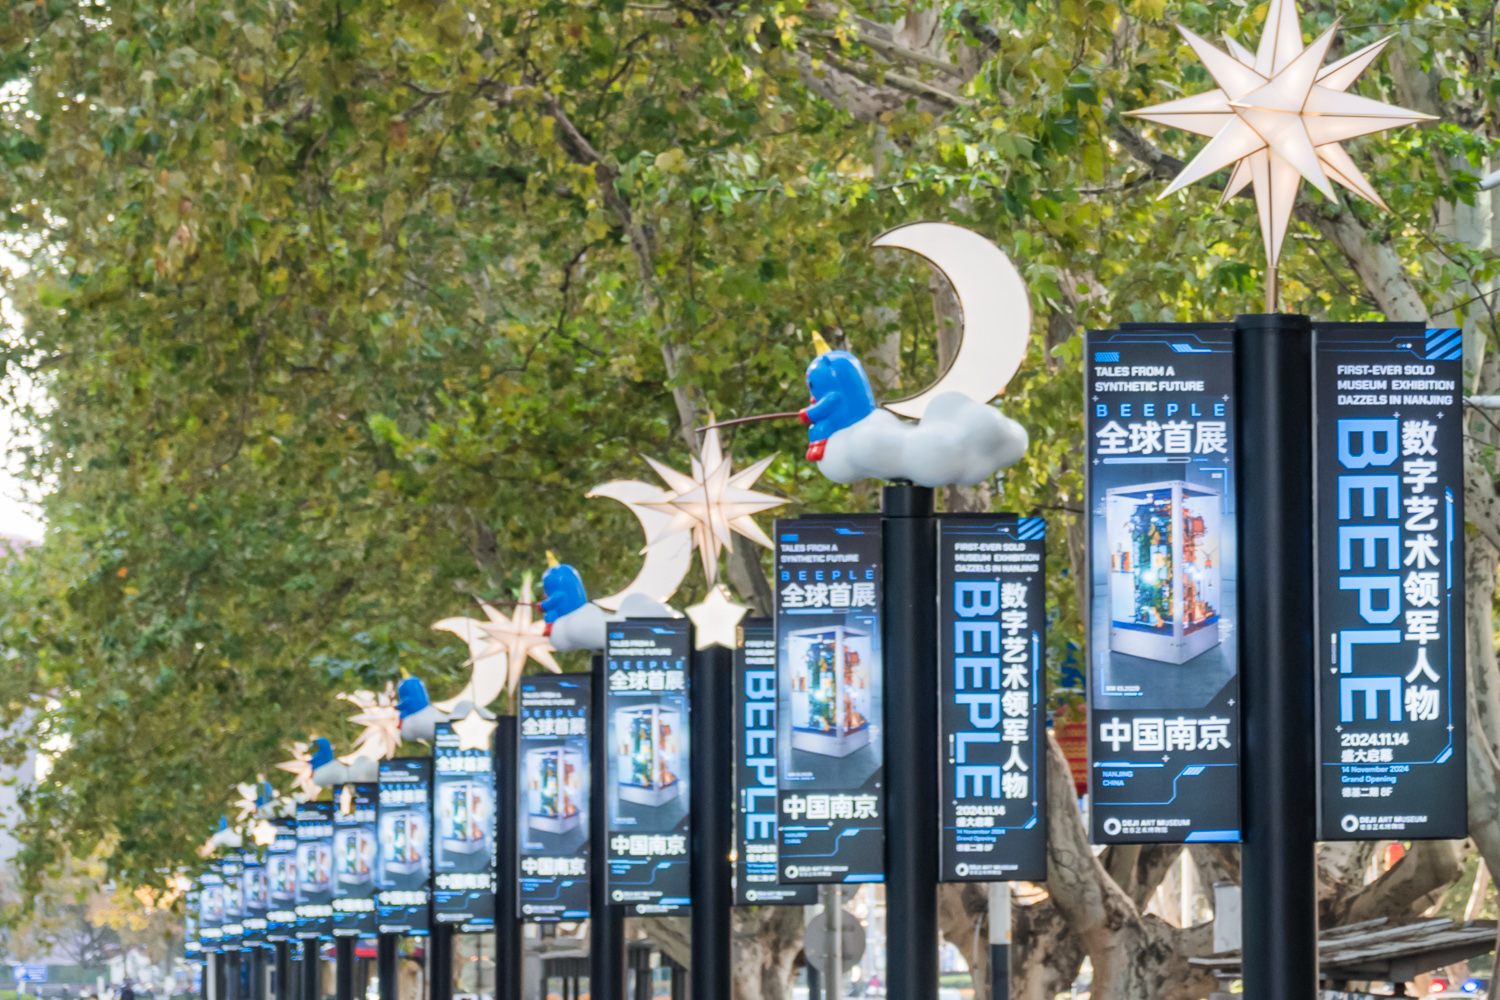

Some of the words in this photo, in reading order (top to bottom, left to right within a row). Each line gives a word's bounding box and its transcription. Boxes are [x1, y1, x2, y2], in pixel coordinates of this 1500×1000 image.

[1094, 366, 1130, 377] TALES
[1131, 366, 1164, 376] FROM
[1165, 366, 1175, 376] A
[1337, 365, 1402, 375] FIRST-EVER
[1404, 365, 1435, 375] SOLO
[1095, 381, 1157, 392] SYNTHETIC
[1159, 380, 1205, 391] FUTURE
[1337, 380, 1387, 391] MUSEUM
[1391, 380, 1455, 391] EXHIBITION
[1337, 395, 1388, 405] DAZZELS
[1389, 395, 1401, 405] IN
[1403, 394, 1453, 405] NANJING
[1096, 403, 1225, 417] BEEPLE
[1096, 420, 1228, 455] 全球首展
[781, 569, 874, 581] BEEPLE
[1337, 418, 1403, 722] BEEPLE
[1402, 420, 1440, 721] 数字艺术领军人物
[781, 582, 876, 608] 全球首展
[954, 580, 1001, 799] BEEPLE
[1001, 582, 1028, 799] 数字艺术领军人物
[1100, 716, 1231, 752] 中国南京
[1340, 732, 1410, 746] 2024.11.14
[783, 793, 879, 820] 中国南京
